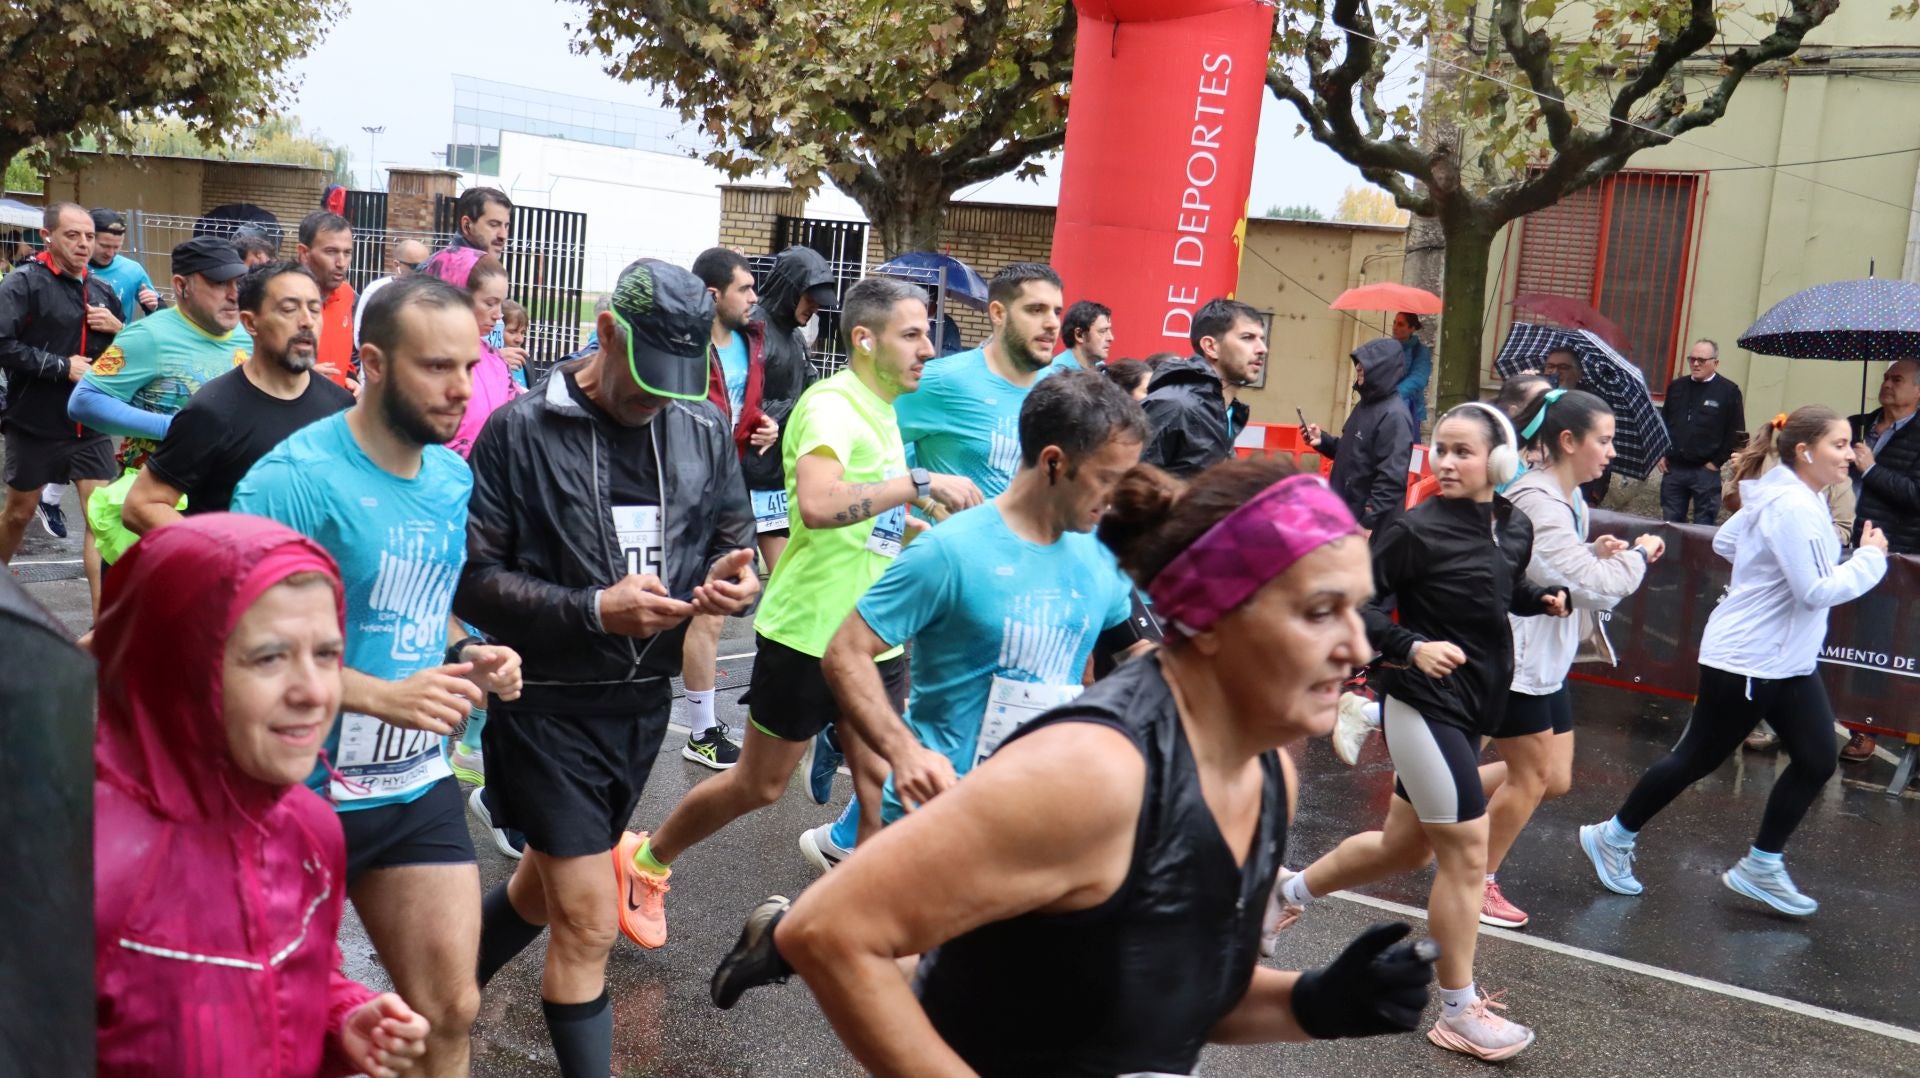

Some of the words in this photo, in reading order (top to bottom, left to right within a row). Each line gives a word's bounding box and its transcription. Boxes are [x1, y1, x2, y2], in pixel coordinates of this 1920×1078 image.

[1173, 53, 1232, 267] DEPORTES
[1162, 285, 1198, 338] DE
[1893, 656, 1916, 670] DE
